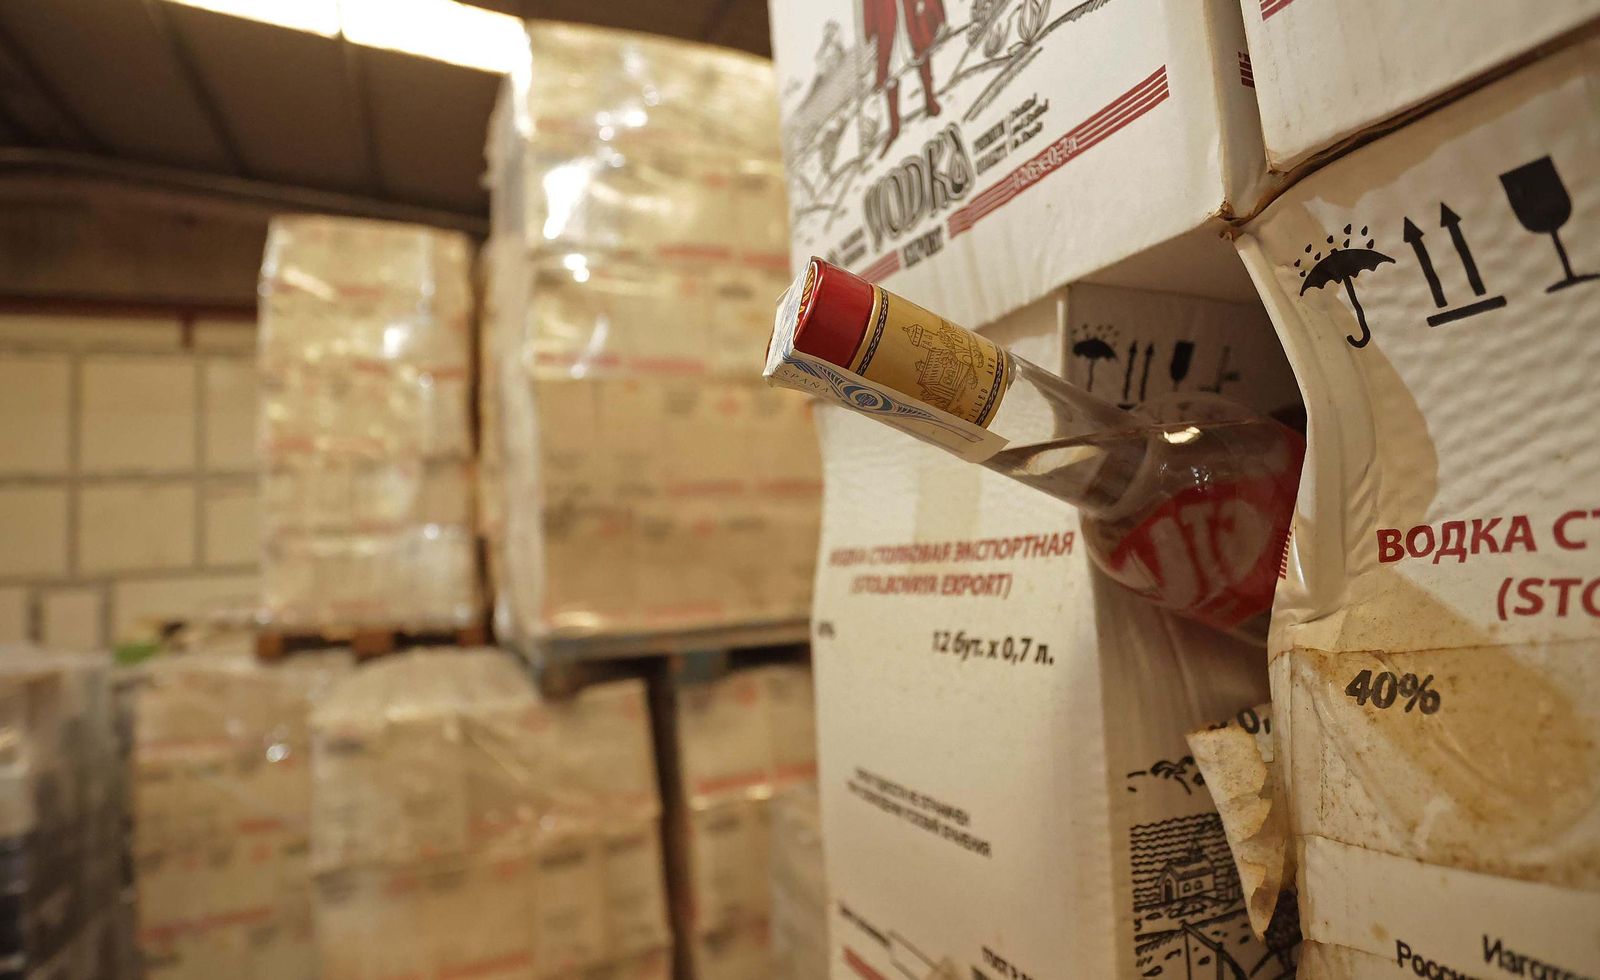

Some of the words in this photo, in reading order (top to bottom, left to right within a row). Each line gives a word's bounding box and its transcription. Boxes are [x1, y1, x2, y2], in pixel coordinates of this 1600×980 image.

[864, 122, 975, 255] VODKA
[953, 531, 1075, 562] ЭКСПОРТНАЯ
[1376, 514, 1537, 565] ВОДКА
[1552, 509, 1600, 551] С
[932, 630, 950, 653] 12
[952, 631, 983, 661] бут.
[1002, 636, 1031, 665] 0,7
[1034, 643, 1054, 665] л.
[1344, 668, 1441, 714] 40%
[1237, 708, 1271, 735] 0,
